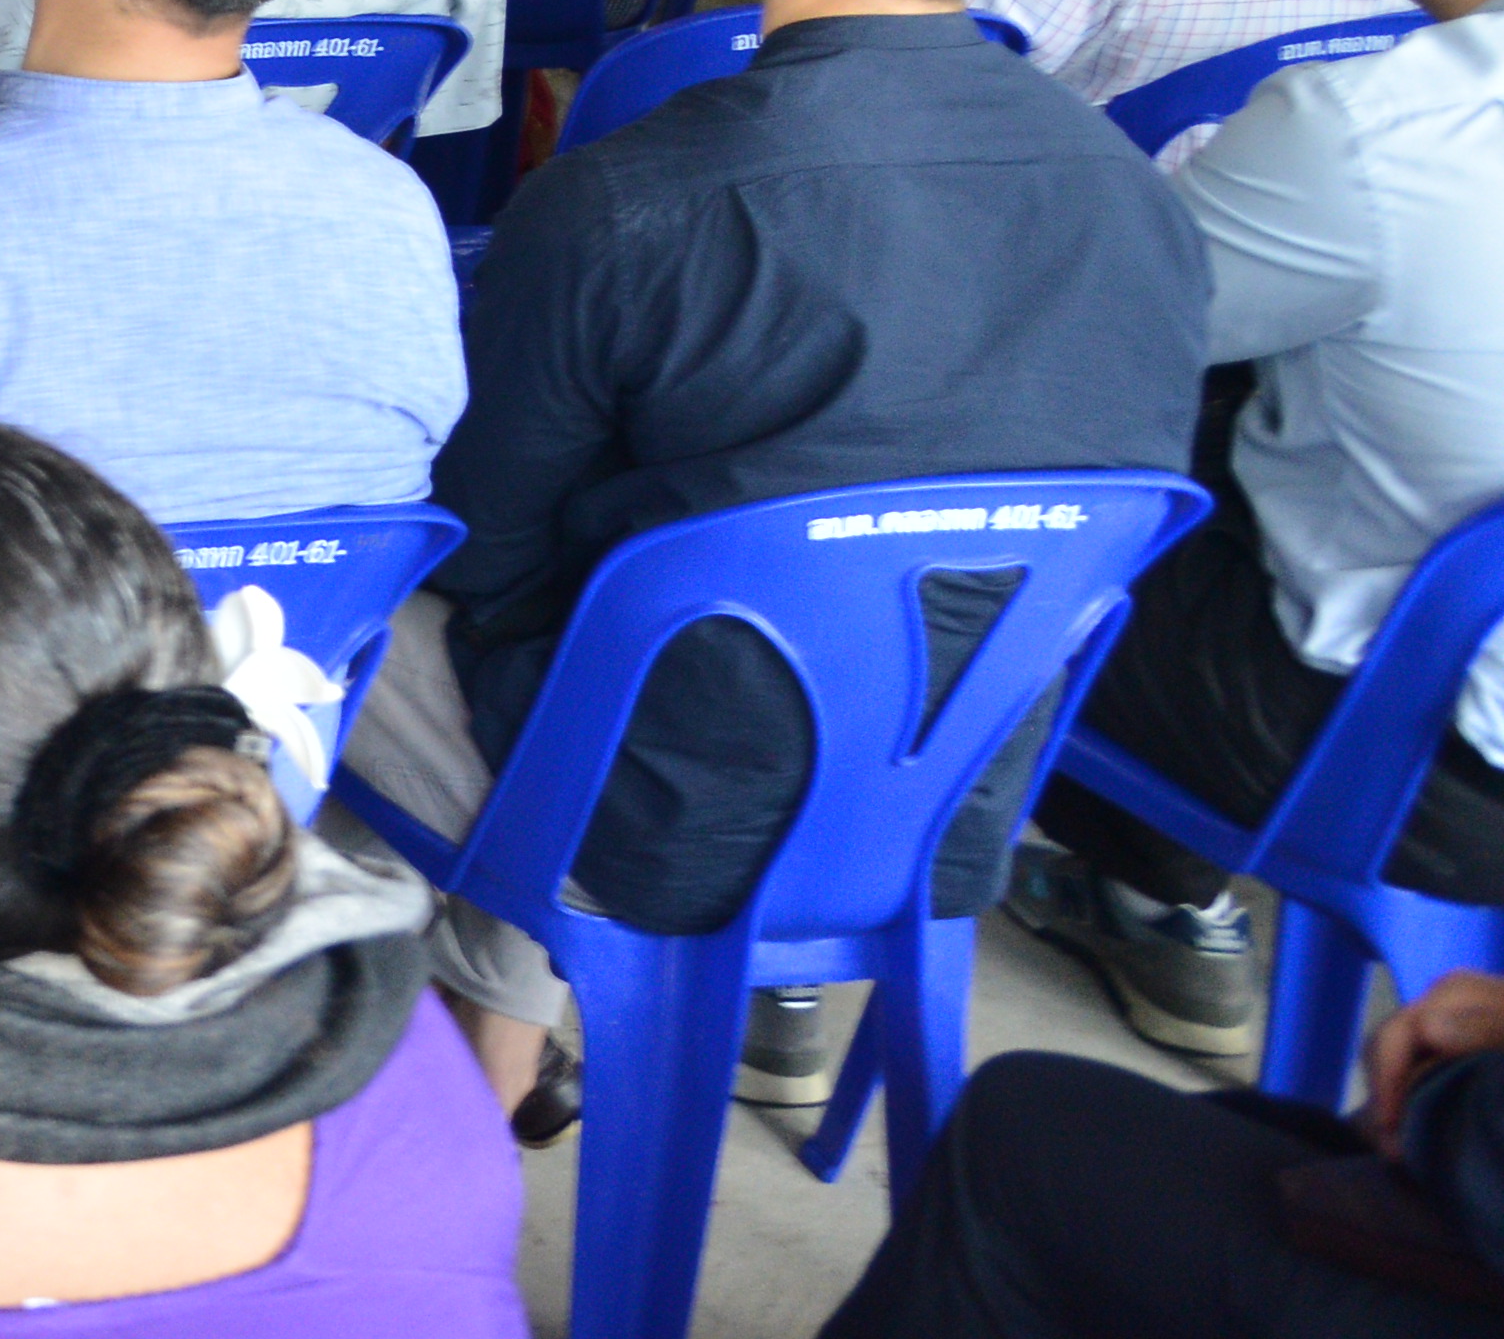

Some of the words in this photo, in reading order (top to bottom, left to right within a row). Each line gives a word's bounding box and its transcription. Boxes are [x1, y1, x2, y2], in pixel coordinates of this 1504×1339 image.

[311, 38, 385, 58] 401-61-
[990, 504, 1088, 530] 401-61-
[247, 539, 347, 567] 401-61-
